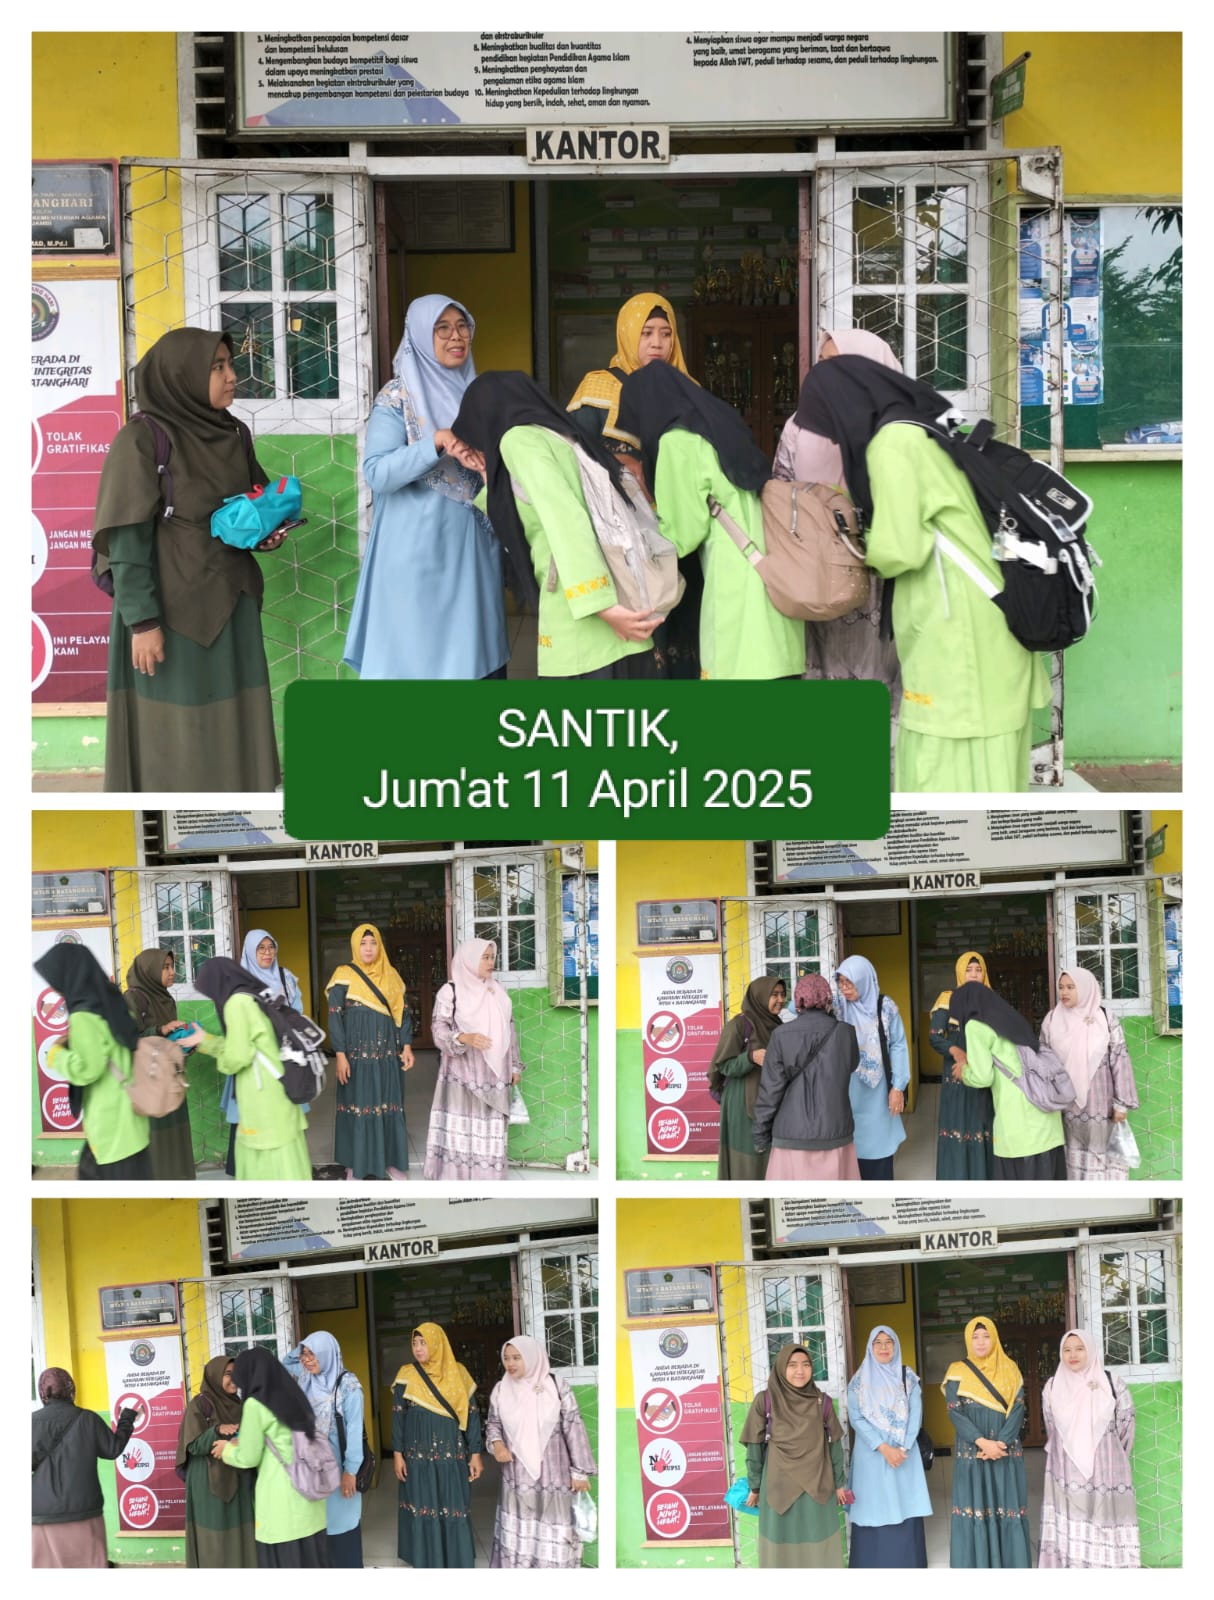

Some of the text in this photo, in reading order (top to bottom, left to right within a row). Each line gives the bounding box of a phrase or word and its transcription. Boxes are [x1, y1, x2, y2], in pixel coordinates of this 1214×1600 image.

[391, 33, 409, 41] dasar
[480, 32, 493, 40] dan
[264, 45, 277, 53] dan
[557, 42, 569, 50] dan
[846, 44, 858, 52] dan
[323, 56, 348, 65] budaya
[385, 55, 399, 65] bagi
[401, 55, 418, 64] siswa
[588, 53, 611, 63] Agama
[720, 58, 736, 66] Allah
[265, 68, 286, 76] dalam
[575, 64, 587, 72] dan
[393, 89, 405, 97] dan
[444, 88, 469, 98] budaya
[486, 99, 504, 108] hidup
[608, 98, 620, 106] dan
[535, 130, 661, 160] KANTOR
[69, 354, 80, 363] DI
[34, 366, 92, 376] INTEGRITAS
[46, 431, 82, 441] TOLAK
[49, 530, 79, 539] JANGAN
[50, 541, 79, 550] JANGAN
[53, 636, 67, 645] INI
[54, 647, 79, 656] KAMI
[310, 843, 374, 860] KANTOR
[914, 873, 976, 890] KANTOR
[925, 1230, 993, 1250] KANTOR
[368, 1240, 434, 1261] KANTOR
